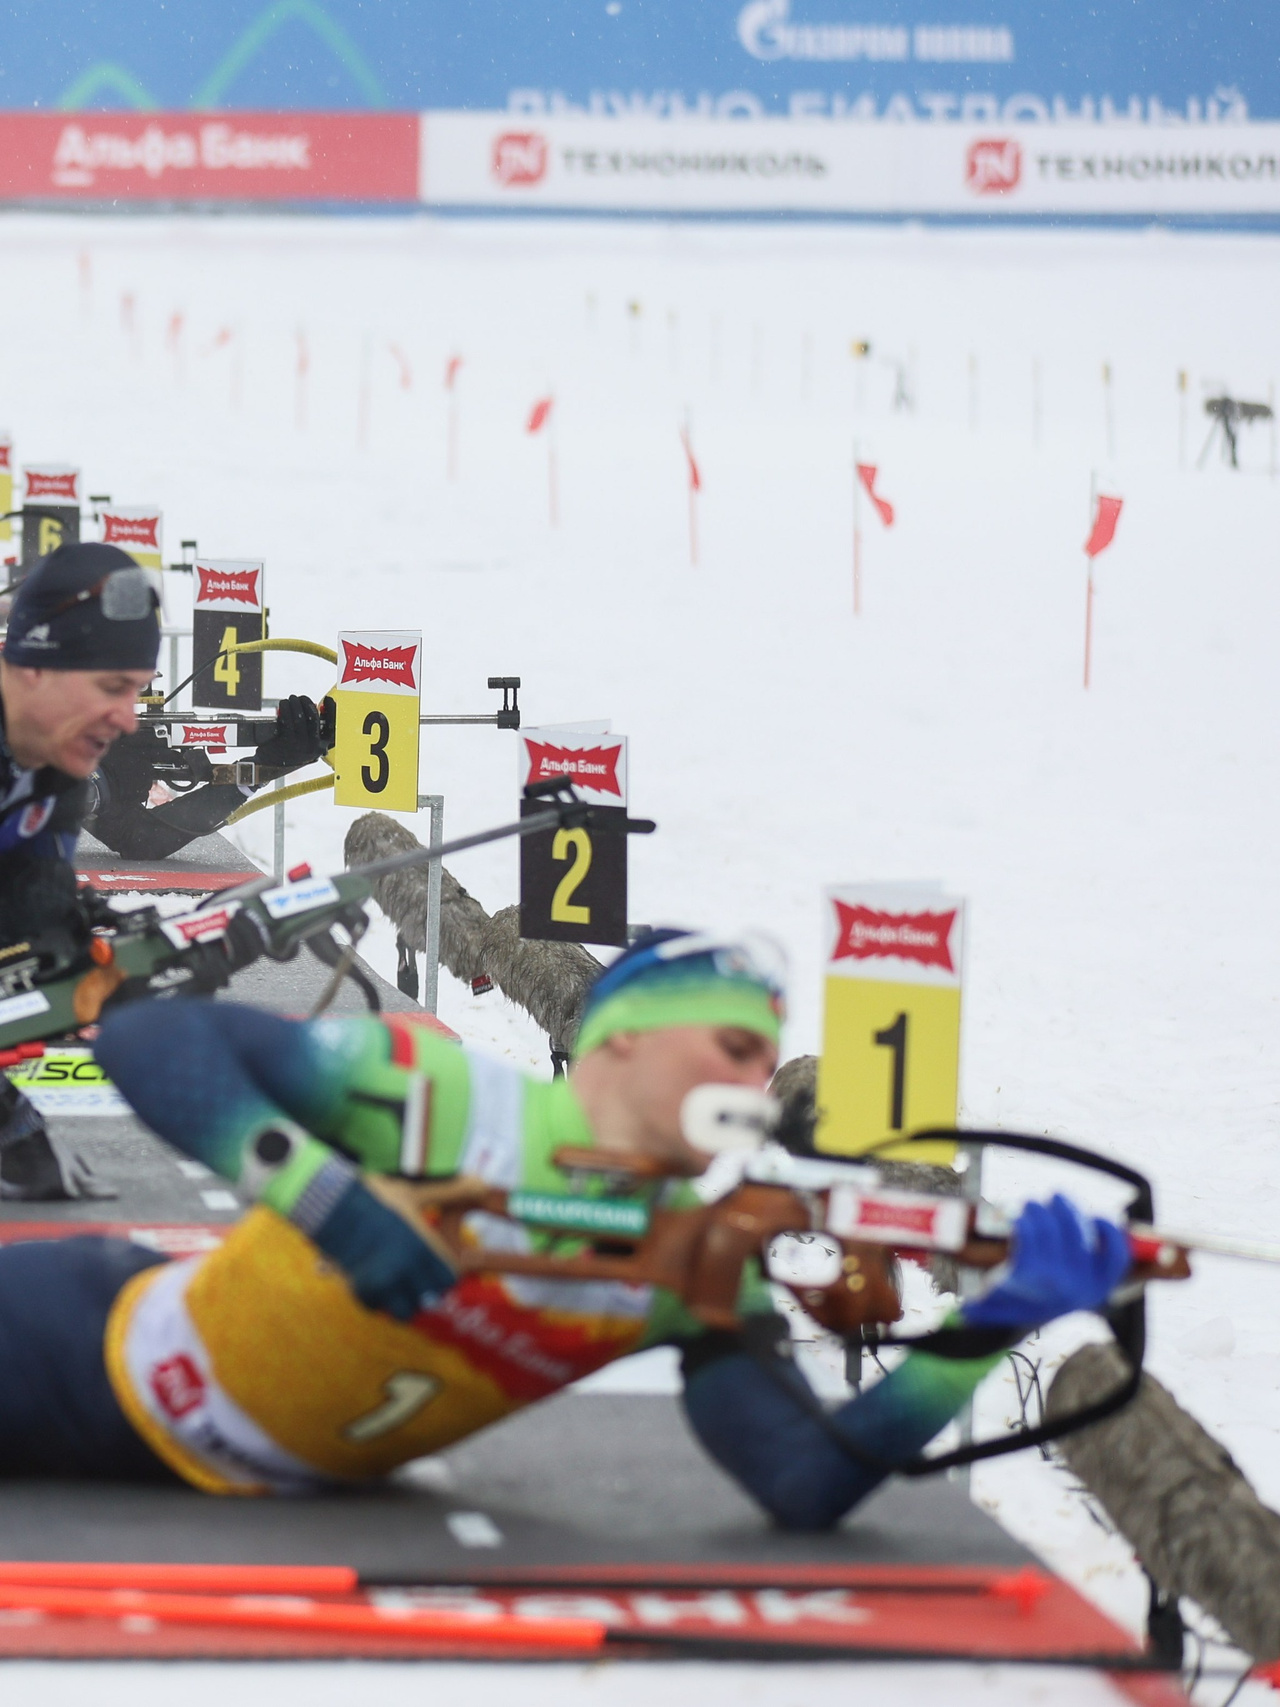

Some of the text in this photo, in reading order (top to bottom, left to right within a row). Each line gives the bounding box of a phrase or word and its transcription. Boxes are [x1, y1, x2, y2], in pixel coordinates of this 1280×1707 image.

[231, 580, 249, 591] Банк
[214, 626, 241, 697] 4
[353, 655, 405, 672] Альфа Банк
[361, 711, 390, 794] 3
[539, 757, 607, 776] Альфа Банк
[550, 827, 593, 926] 2
[873, 1011, 908, 1131] 1
[342, 1369, 443, 1445] 1
